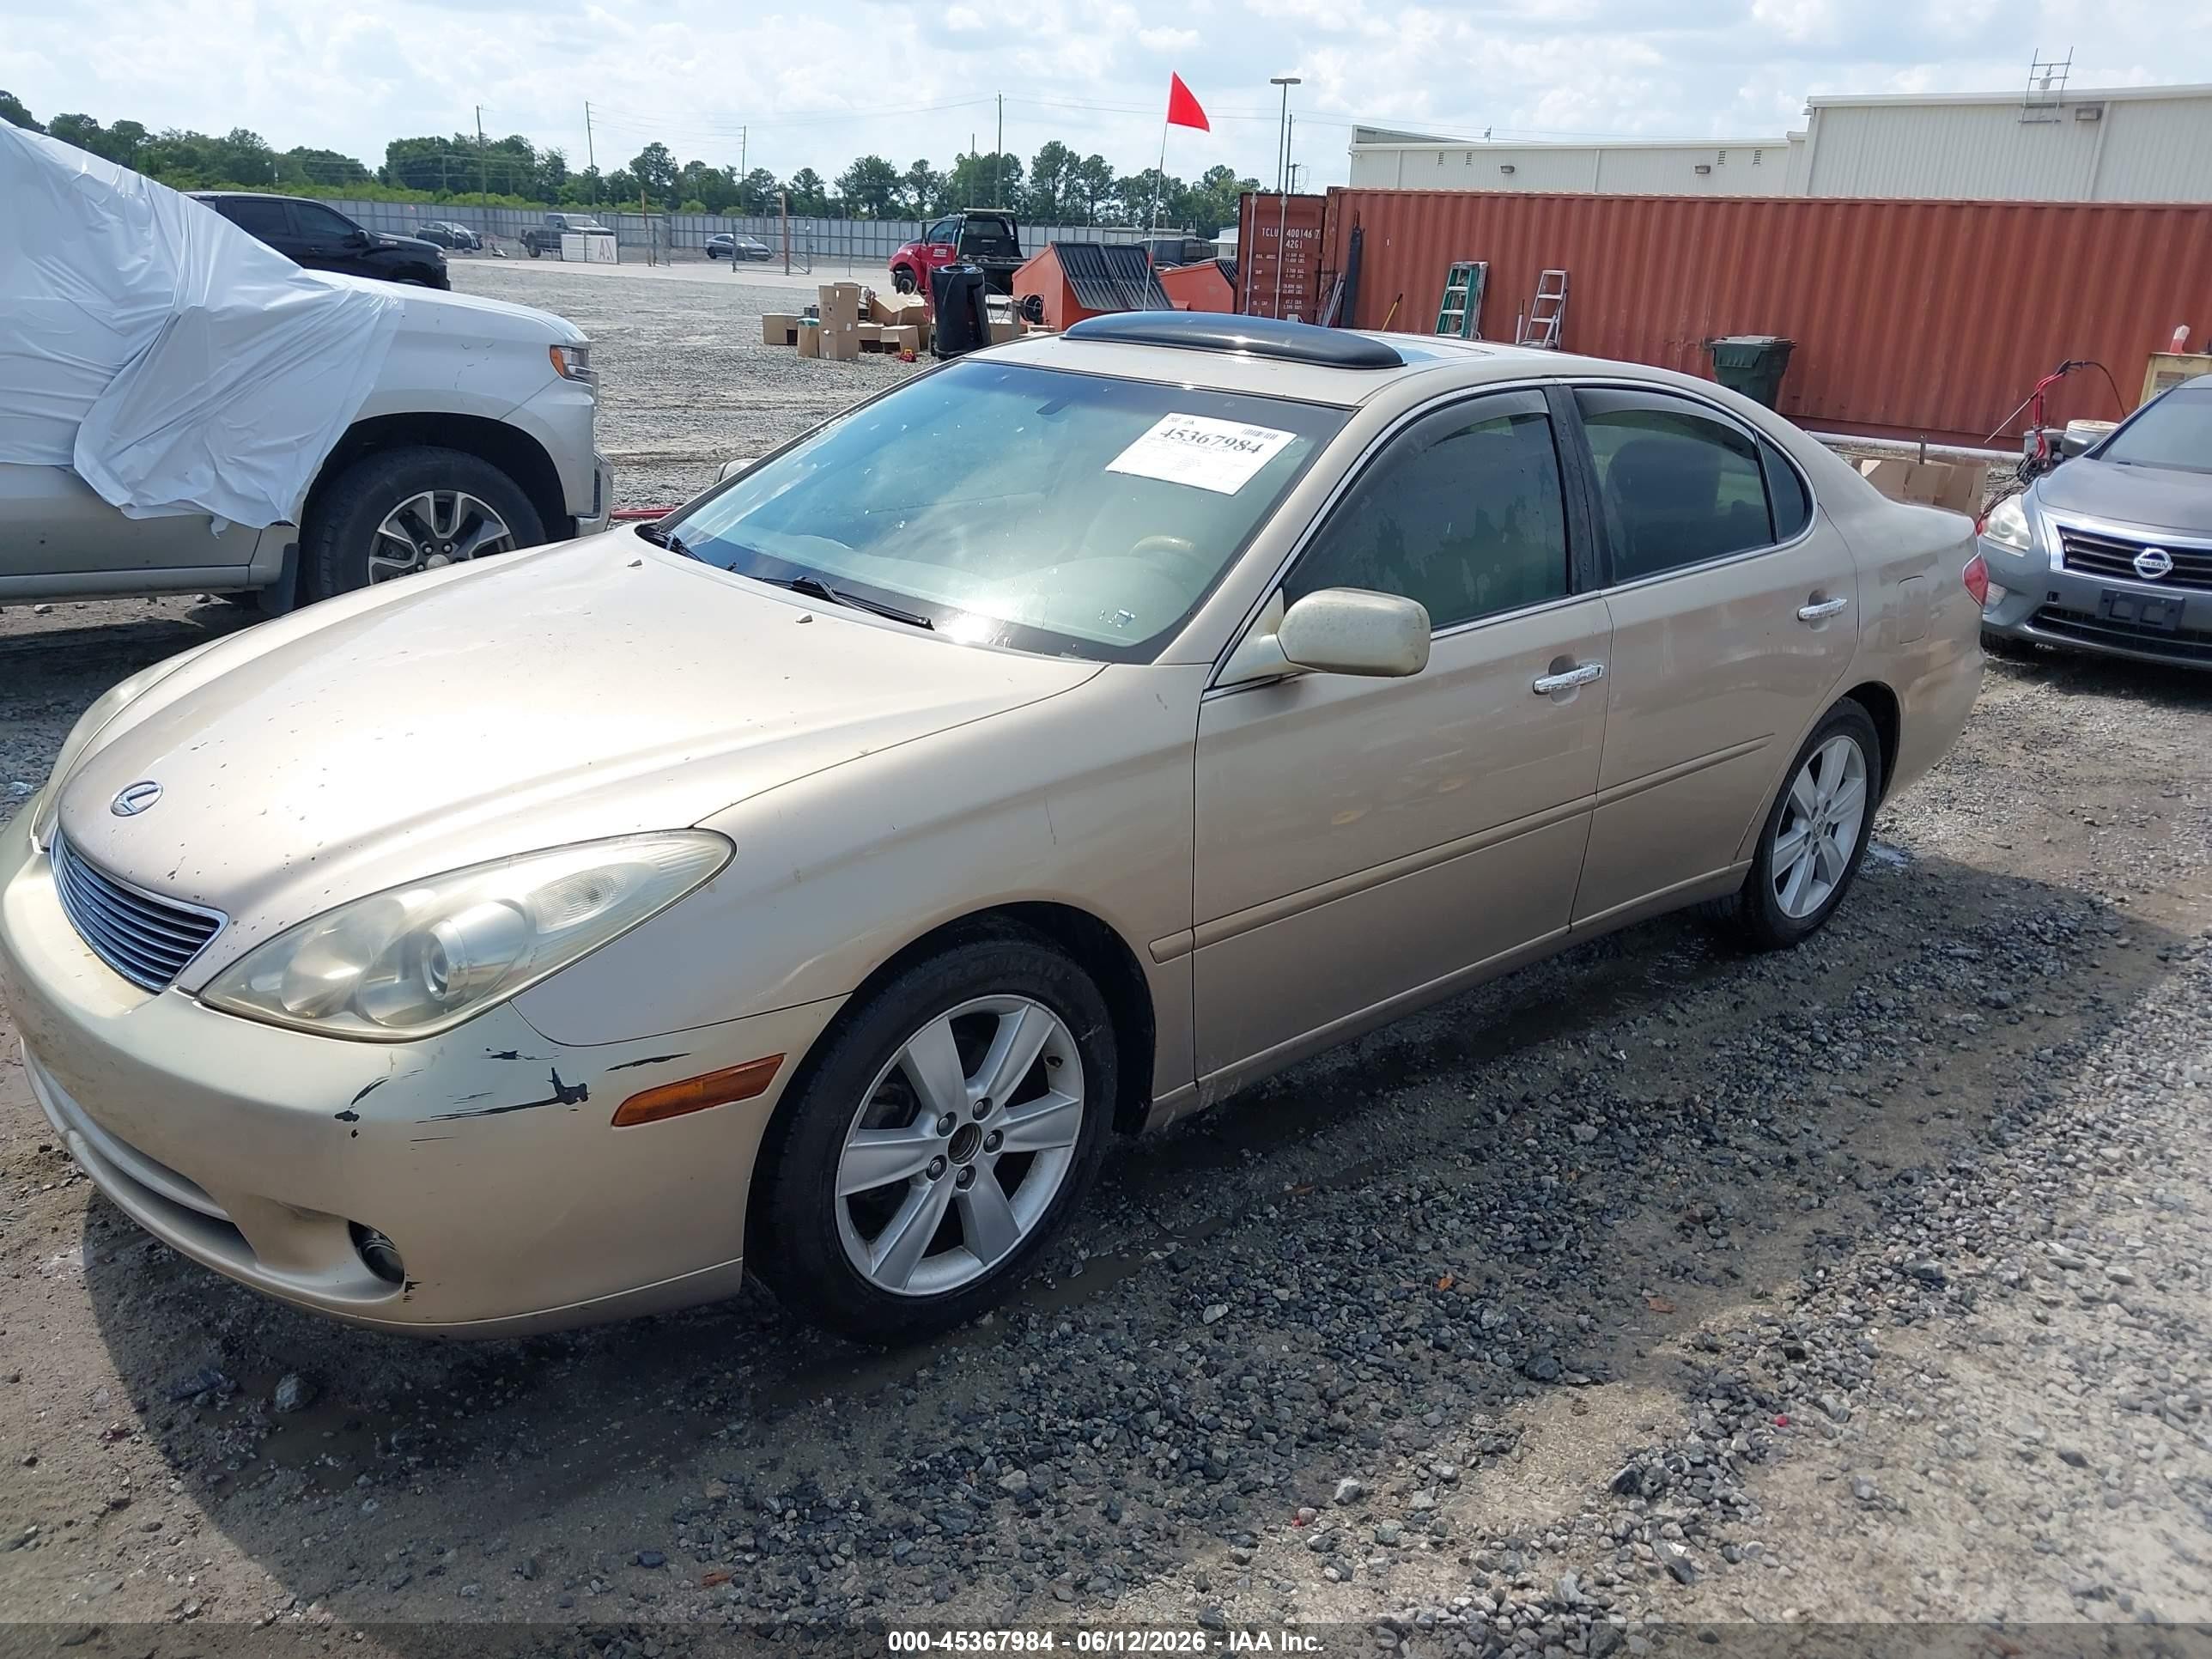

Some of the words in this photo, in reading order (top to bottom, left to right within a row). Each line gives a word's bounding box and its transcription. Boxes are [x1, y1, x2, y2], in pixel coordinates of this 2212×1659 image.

[1261, 227, 1279, 237] TCLU
[1286, 228, 1312, 239] 400146
[1285, 239, 1303, 249] 42G1
[1160, 427, 1265, 454] 45367984
[2136, 559, 2169, 569] NISSAN
